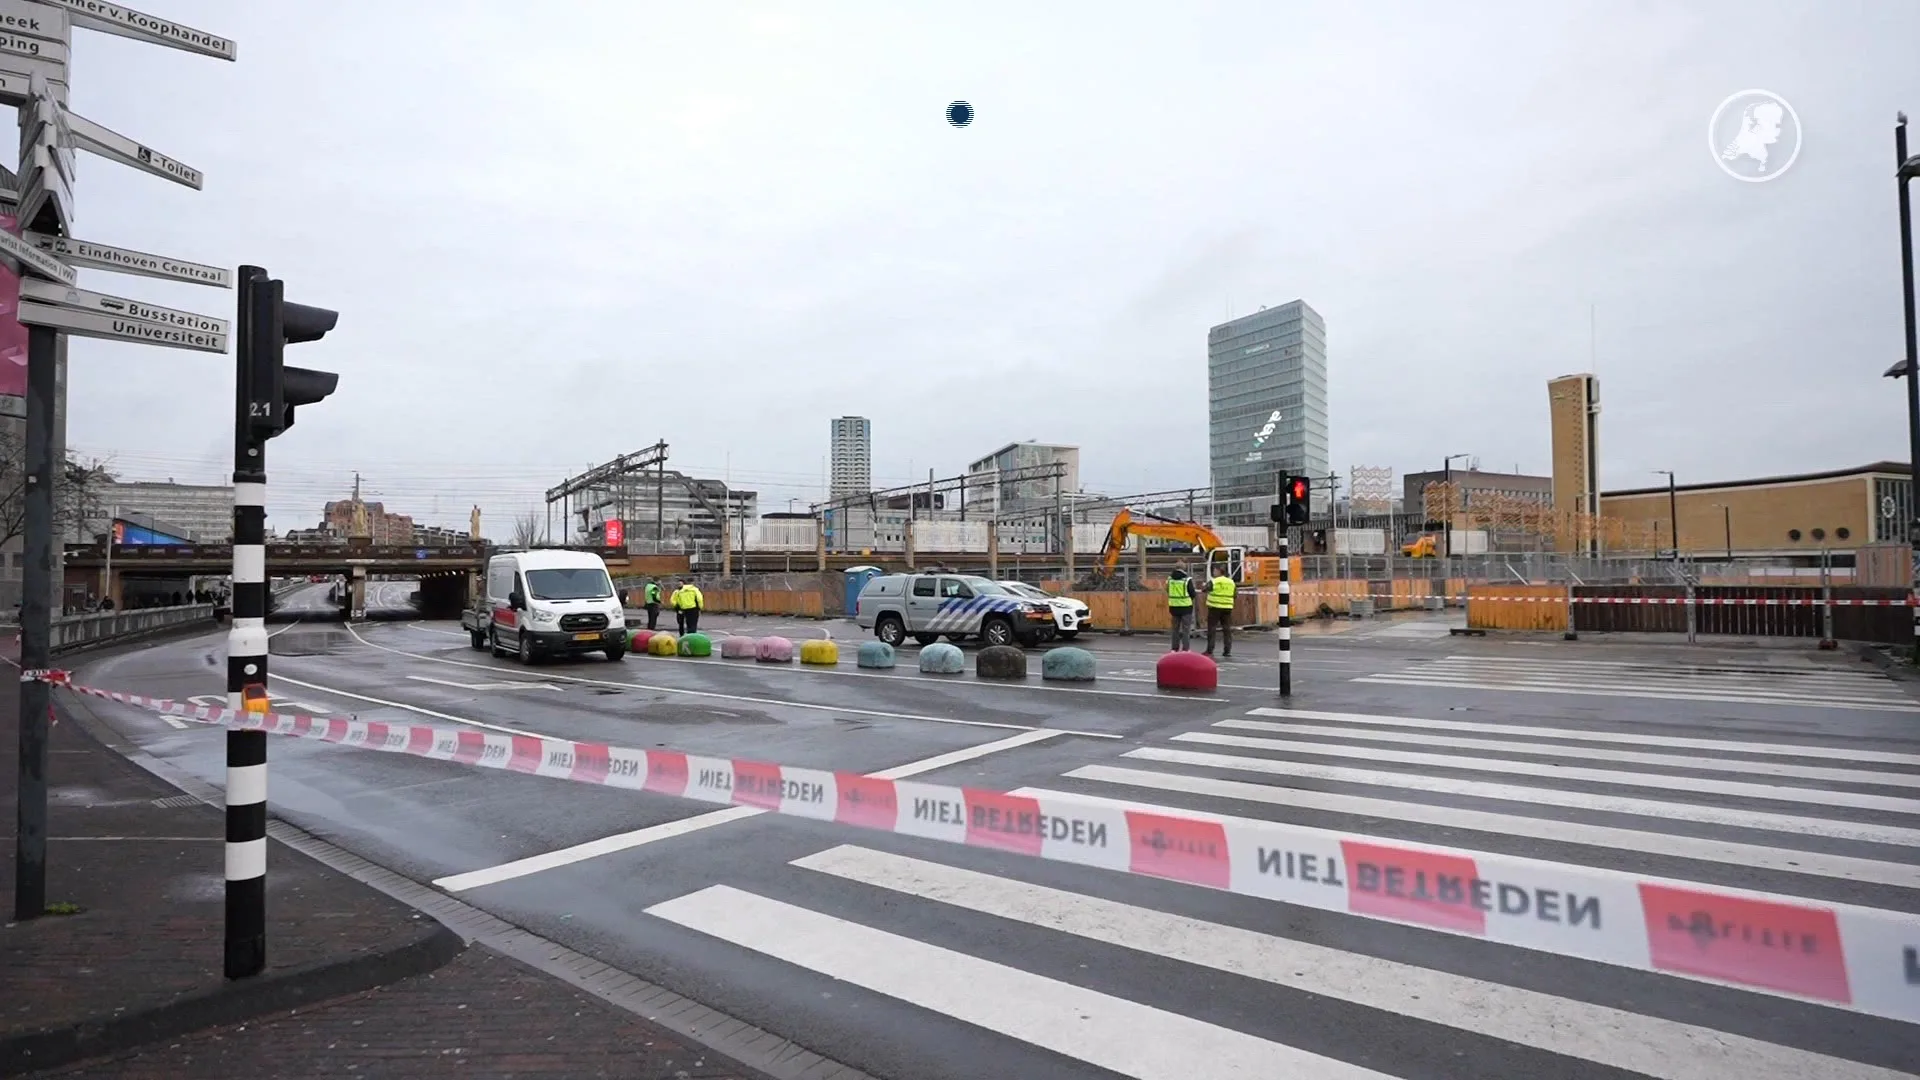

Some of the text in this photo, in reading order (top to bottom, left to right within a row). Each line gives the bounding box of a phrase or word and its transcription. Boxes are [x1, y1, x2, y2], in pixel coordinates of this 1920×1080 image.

[109, 8, 123, 20] v.
[127, 11, 226, 51] Koophandel
[78, 244, 222, 281] Eindhoven Centraal
[129, 303, 220, 333] Busstation
[112, 320, 219, 348] Universiteit
[249, 401, 271, 417] 2.1
